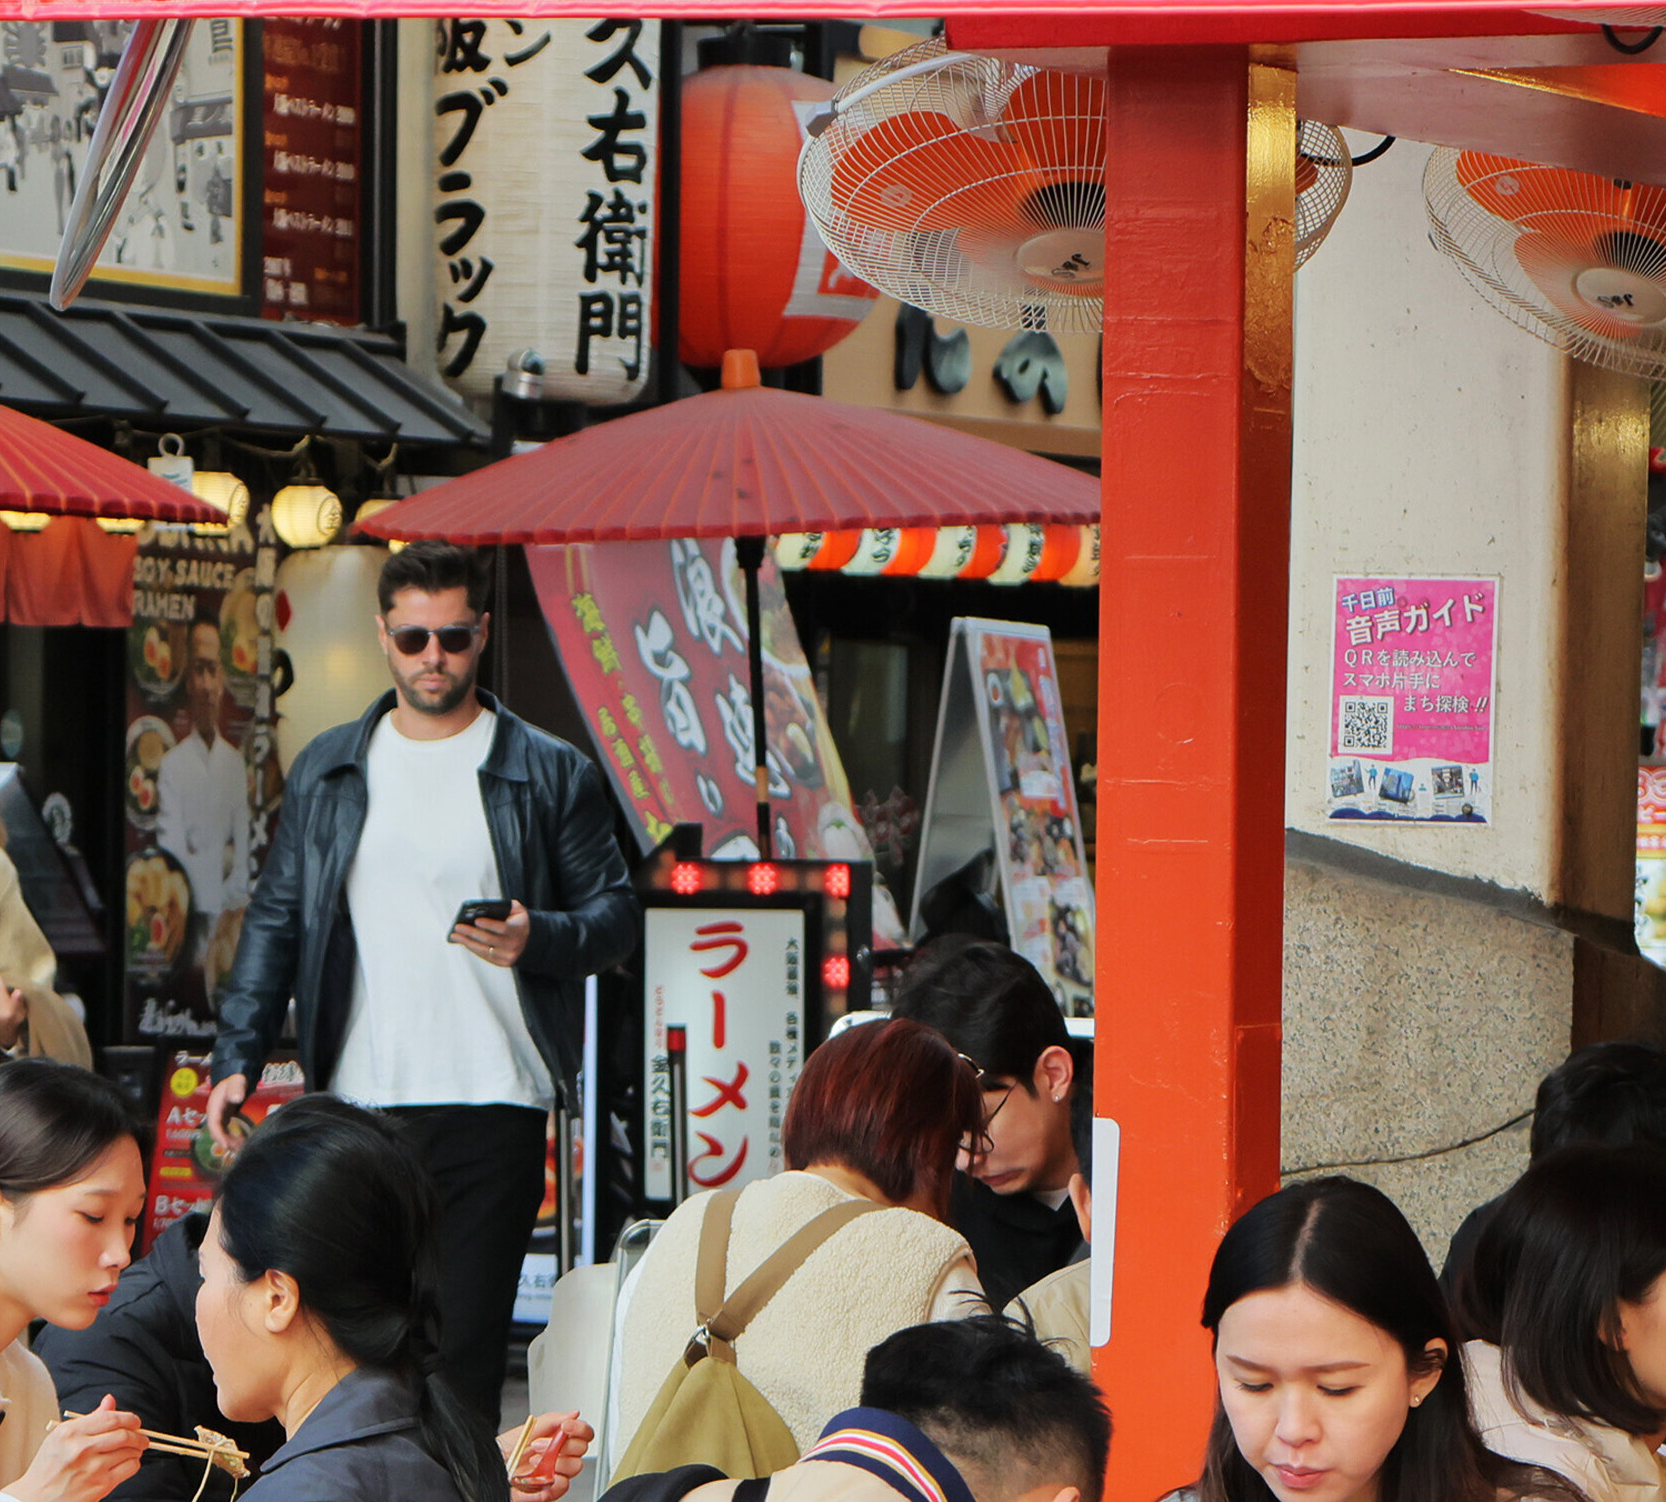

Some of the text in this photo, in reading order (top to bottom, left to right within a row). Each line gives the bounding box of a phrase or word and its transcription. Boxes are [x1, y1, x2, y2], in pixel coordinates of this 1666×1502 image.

[1341, 586, 1396, 613] 千日前
[1346, 592, 1485, 646] 音声ガイド
[1344, 648, 1476, 668] QRを読み込んで
[1343, 671, 1440, 689] スマホ片手に
[689, 920, 750, 1187] ラーメン
